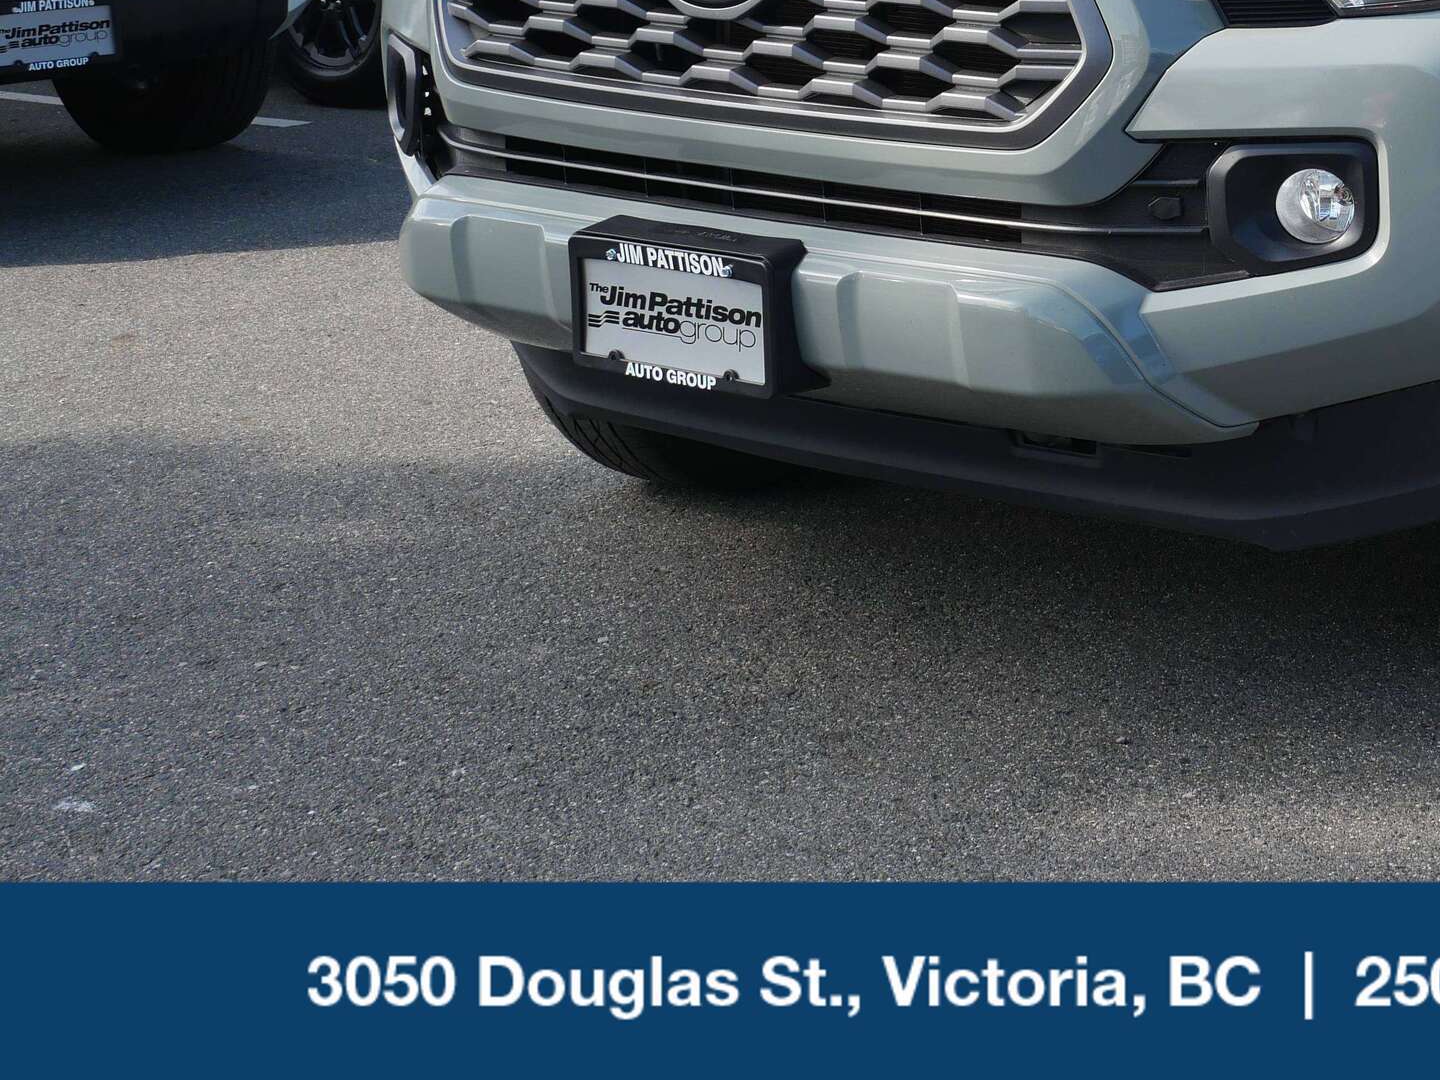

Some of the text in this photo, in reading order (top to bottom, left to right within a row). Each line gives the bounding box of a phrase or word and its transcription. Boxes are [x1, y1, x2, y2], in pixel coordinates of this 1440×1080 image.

[19, 0, 36, 13] JIM
[38, 19, 110, 36] Pattison
[29, 57, 89, 71] AUTO GROUP
[616, 242, 724, 277] JIM PATTISON
[589, 282, 762, 328] The Jim Pattison
[625, 361, 717, 390] AUTO GROUP
